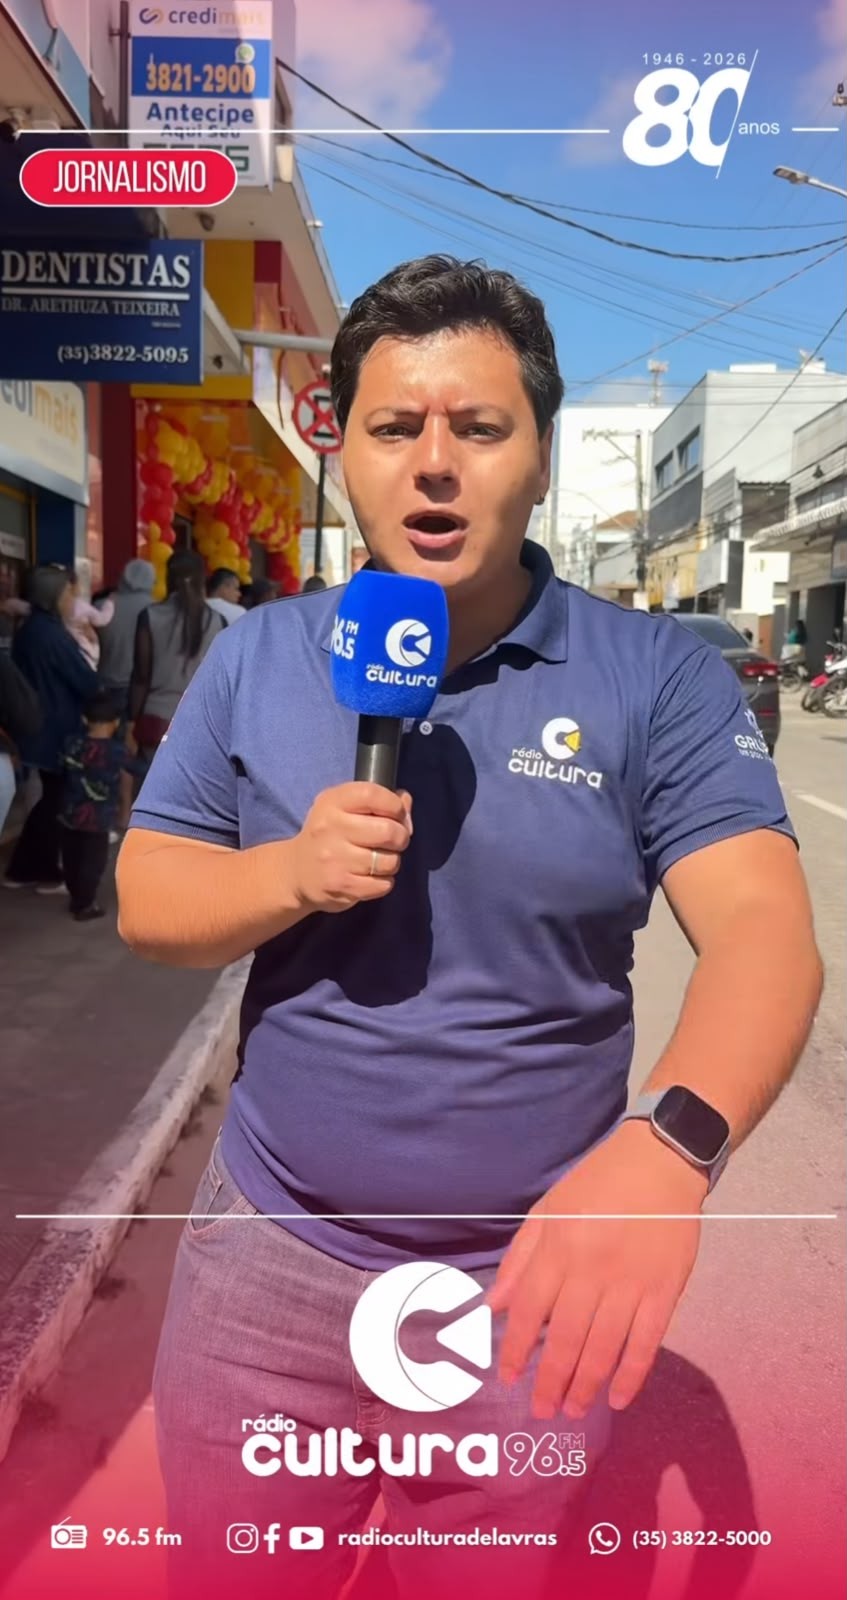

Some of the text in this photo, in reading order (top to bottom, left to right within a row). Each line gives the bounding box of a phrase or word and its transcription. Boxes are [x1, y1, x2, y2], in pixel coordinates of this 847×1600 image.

[146, 63, 255, 93] 3821-2900
[147, 102, 254, 126] Antecipe
[1, 251, 190, 287] DENTISTAS
[1, 297, 27, 312] DR.
[113, 300, 180, 317] TEIXEIRA
[366, 669, 437, 688] cultura
[512, 747, 543, 760] rádio
[508, 758, 602, 788] cultura
